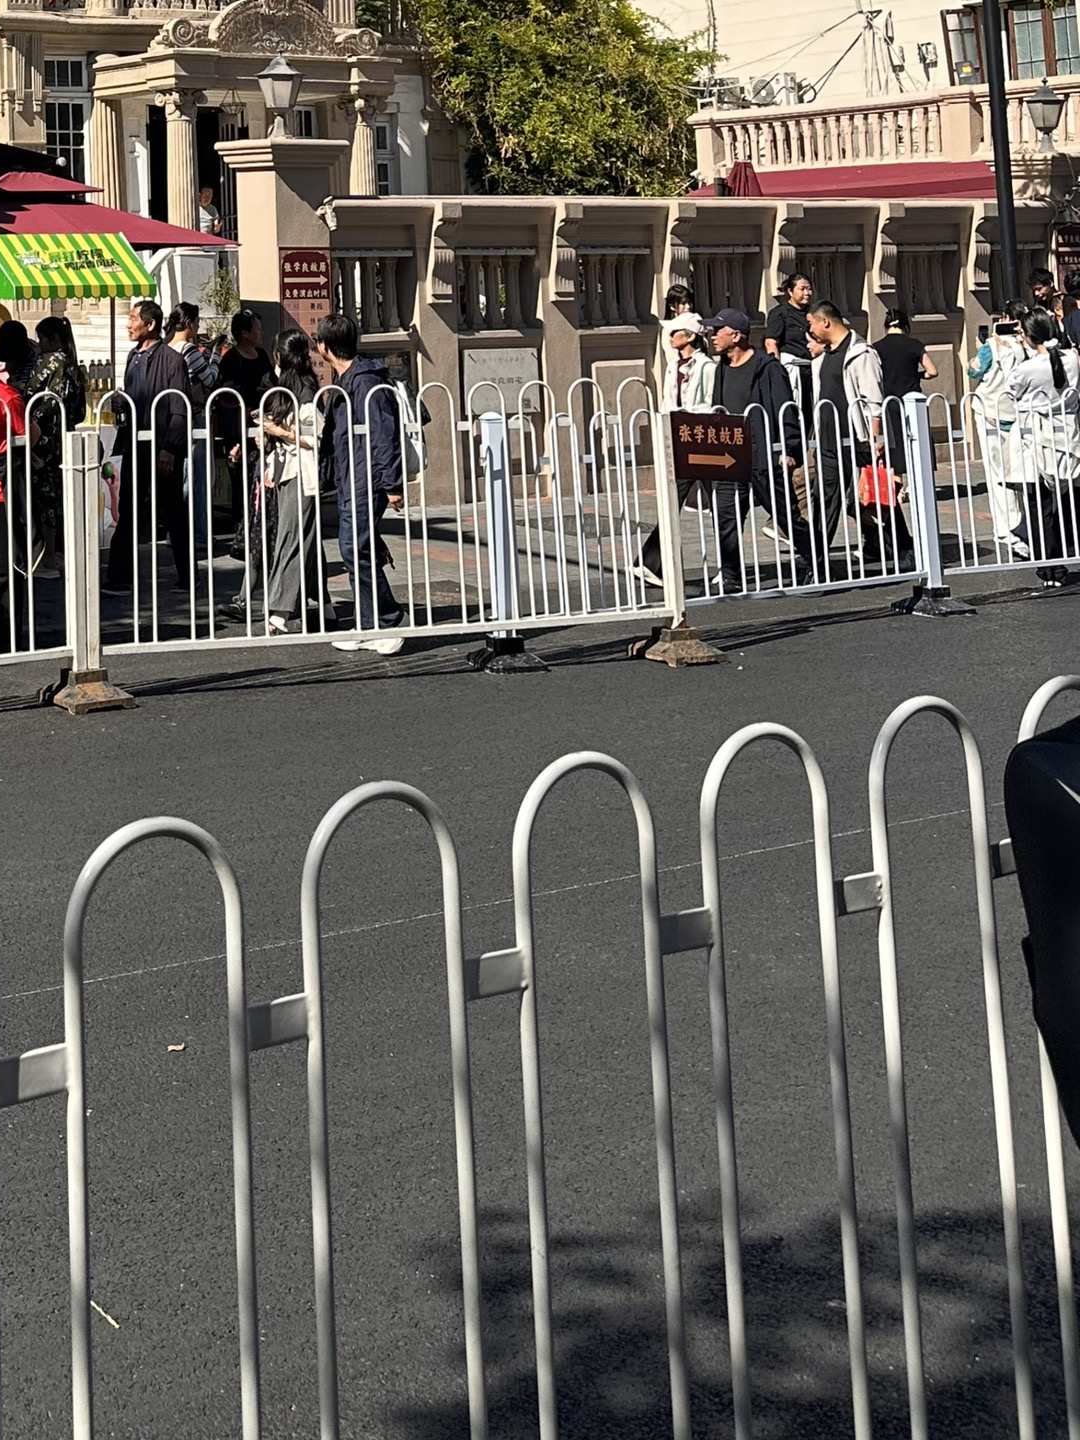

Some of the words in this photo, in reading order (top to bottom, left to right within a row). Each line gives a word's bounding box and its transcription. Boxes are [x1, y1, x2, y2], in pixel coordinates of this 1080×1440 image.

[283, 261, 327, 273] 张学良故居
[284, 288, 328, 298] 免费演出时间
[678, 423, 745, 445] 张学良故居
